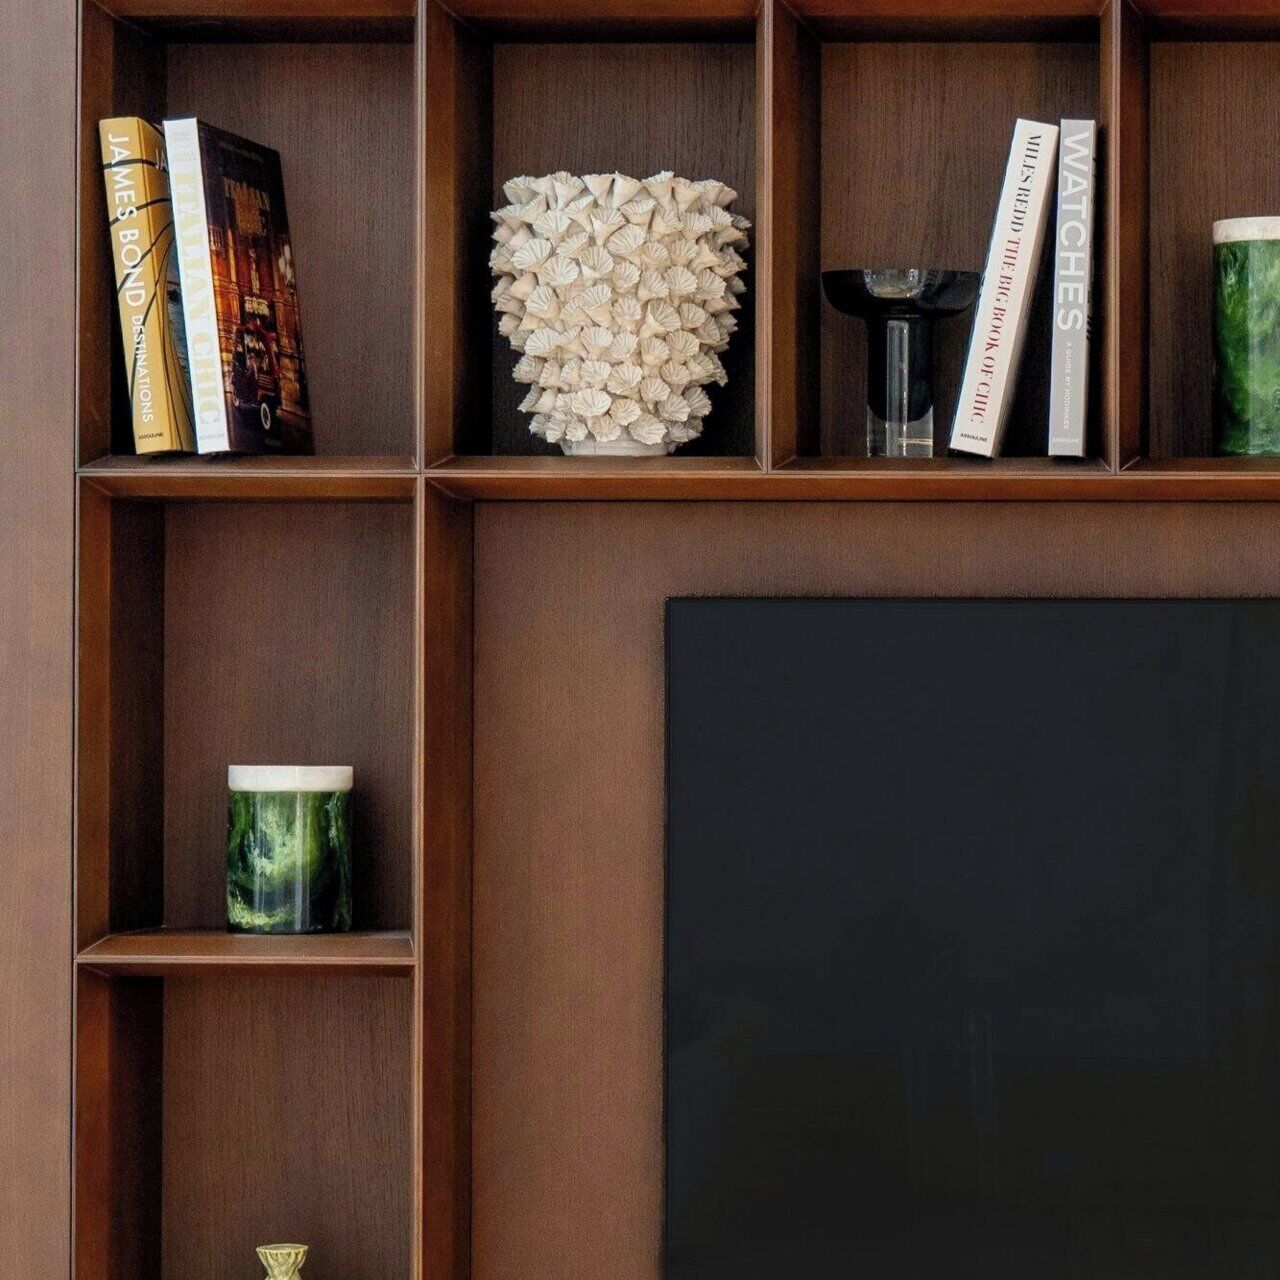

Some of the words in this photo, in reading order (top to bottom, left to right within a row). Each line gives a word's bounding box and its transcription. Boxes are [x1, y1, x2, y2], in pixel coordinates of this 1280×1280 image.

[108, 133, 138, 222] JAMES
[1020, 134, 1043, 185] MILES
[1009, 186, 1032, 233] REDD
[1057, 130, 1090, 332] WATCHES
[118, 229, 146, 308] BOND
[173, 170, 217, 328] ITALIAN
[1003, 237, 1021, 270] THE
[996, 271, 1014, 303] BIG
[984, 304, 1007, 352] BOOK
[131, 315, 154, 424] DESTINATIONS
[190, 333, 221, 426] CHIC
[978, 355, 995, 380] OF
[1064, 349, 1072, 374] GUIDE
[1064, 376, 1072, 387] BY
[970, 382, 990, 425] CHIC
[1062, 388, 1071, 431] HODINKEE
[959, 432, 989, 443] ASSOULINE
